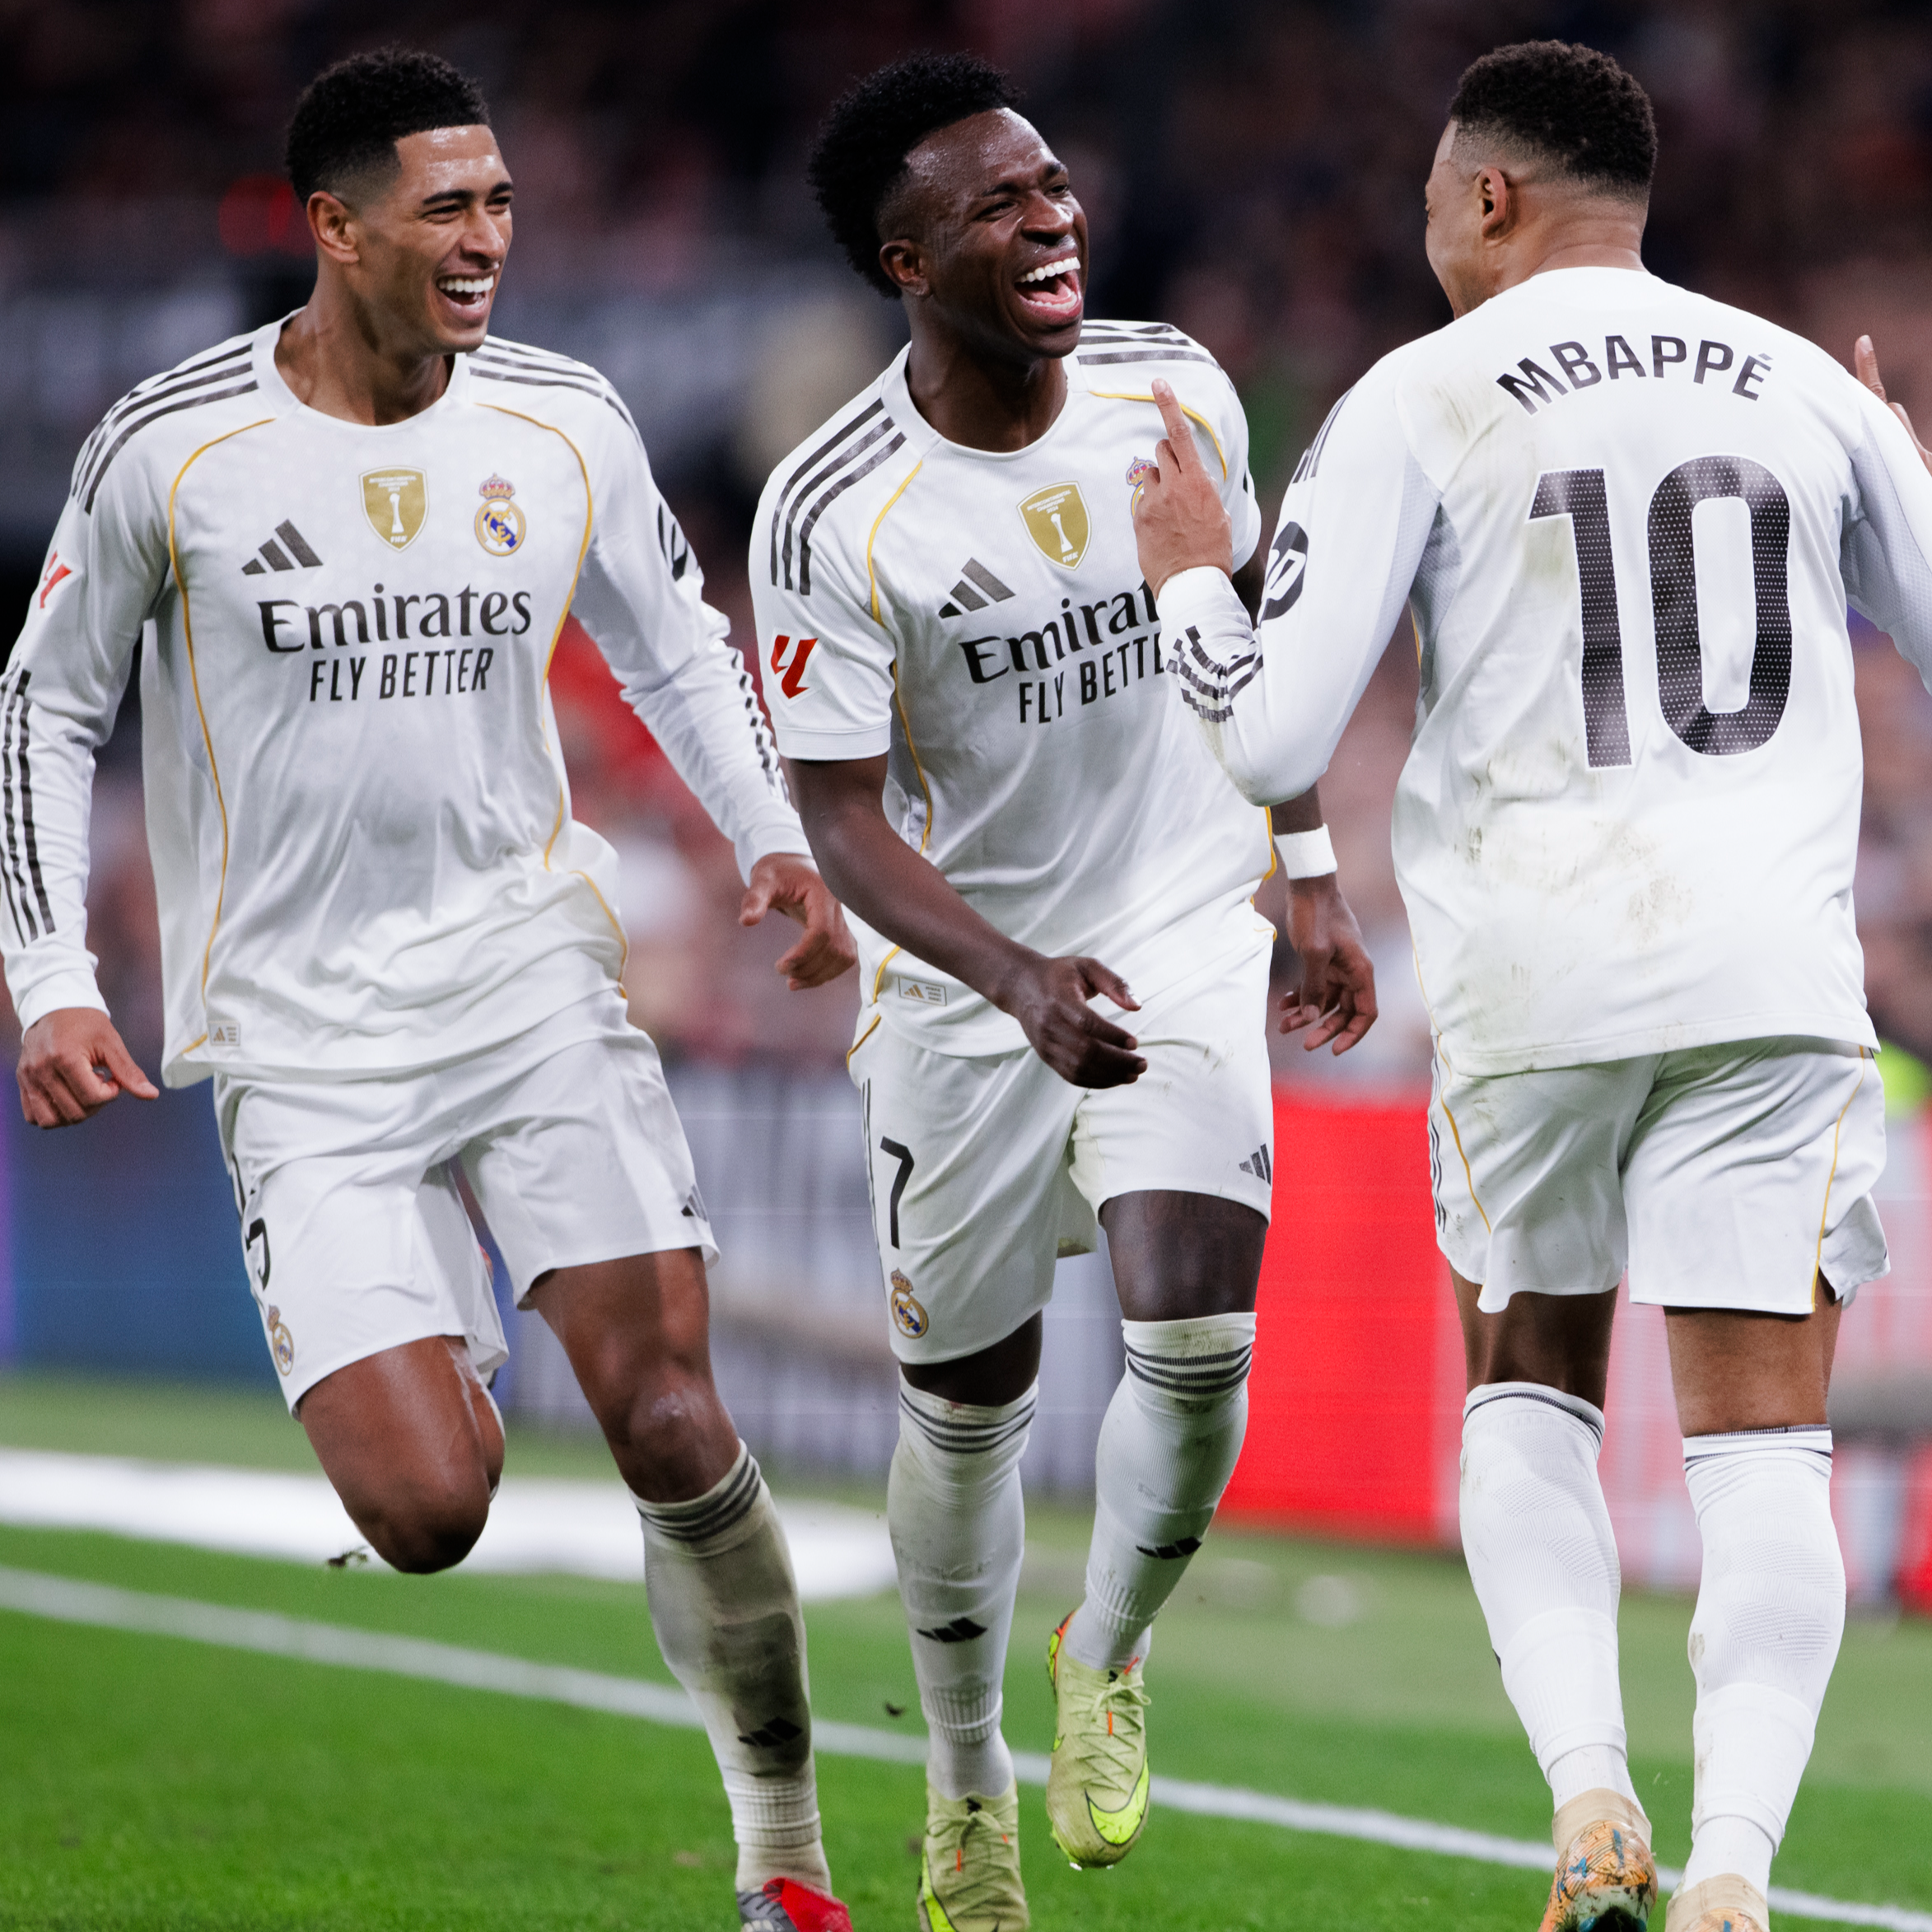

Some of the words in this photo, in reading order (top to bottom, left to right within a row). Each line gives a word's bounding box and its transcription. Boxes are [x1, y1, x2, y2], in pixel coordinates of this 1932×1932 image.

[1496, 334, 1774, 416] MBAPPÉ
[255, 582, 532, 653] Emirates
[958, 578, 1160, 684] Emirat
[1528, 454, 1793, 768] 10
[309, 656, 366, 702] FLY
[379, 647, 494, 700] BETTER
[1019, 670, 1065, 724] FLY
[1080, 631, 1165, 706] BETTE
[880, 1135, 915, 1250] 7
